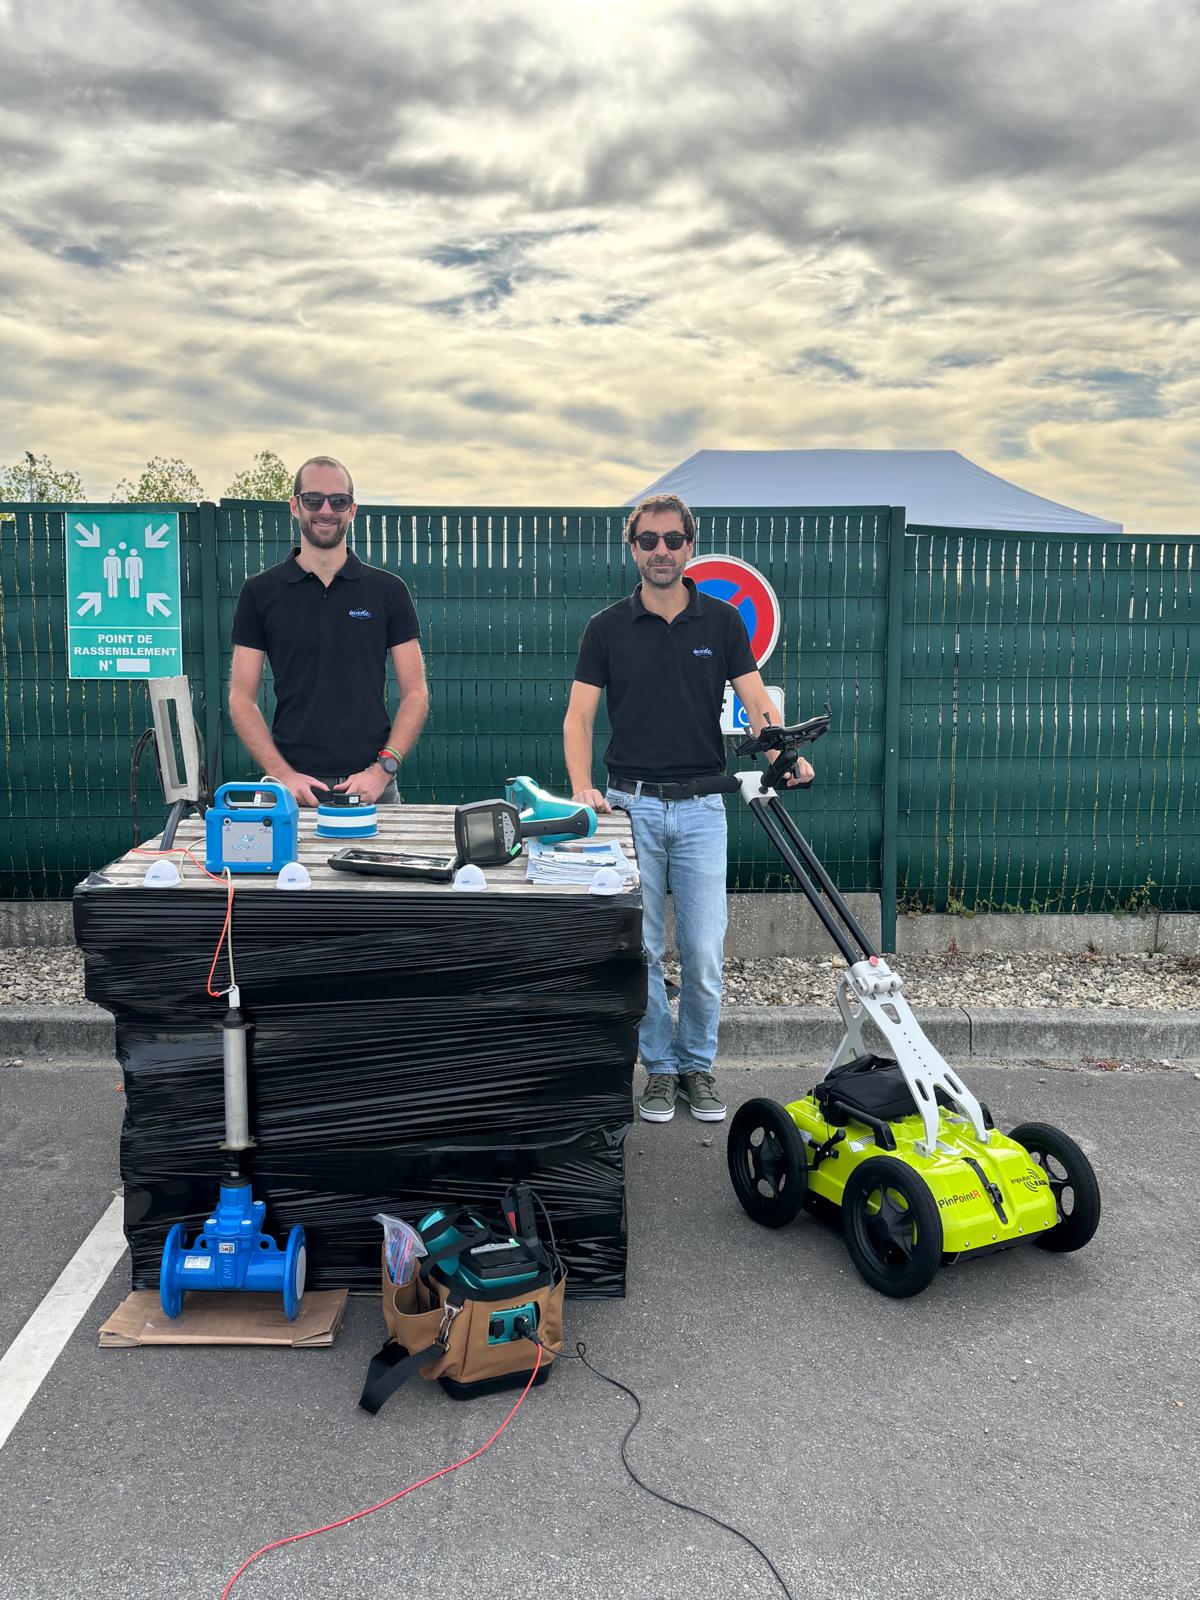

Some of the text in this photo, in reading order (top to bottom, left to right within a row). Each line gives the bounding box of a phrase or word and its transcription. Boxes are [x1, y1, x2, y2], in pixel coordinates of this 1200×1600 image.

[98, 634, 153, 644] POINT DE
[74, 647, 177, 656] RASSEMBLEMENT
[938, 1189, 981, 1208] PinPointR
